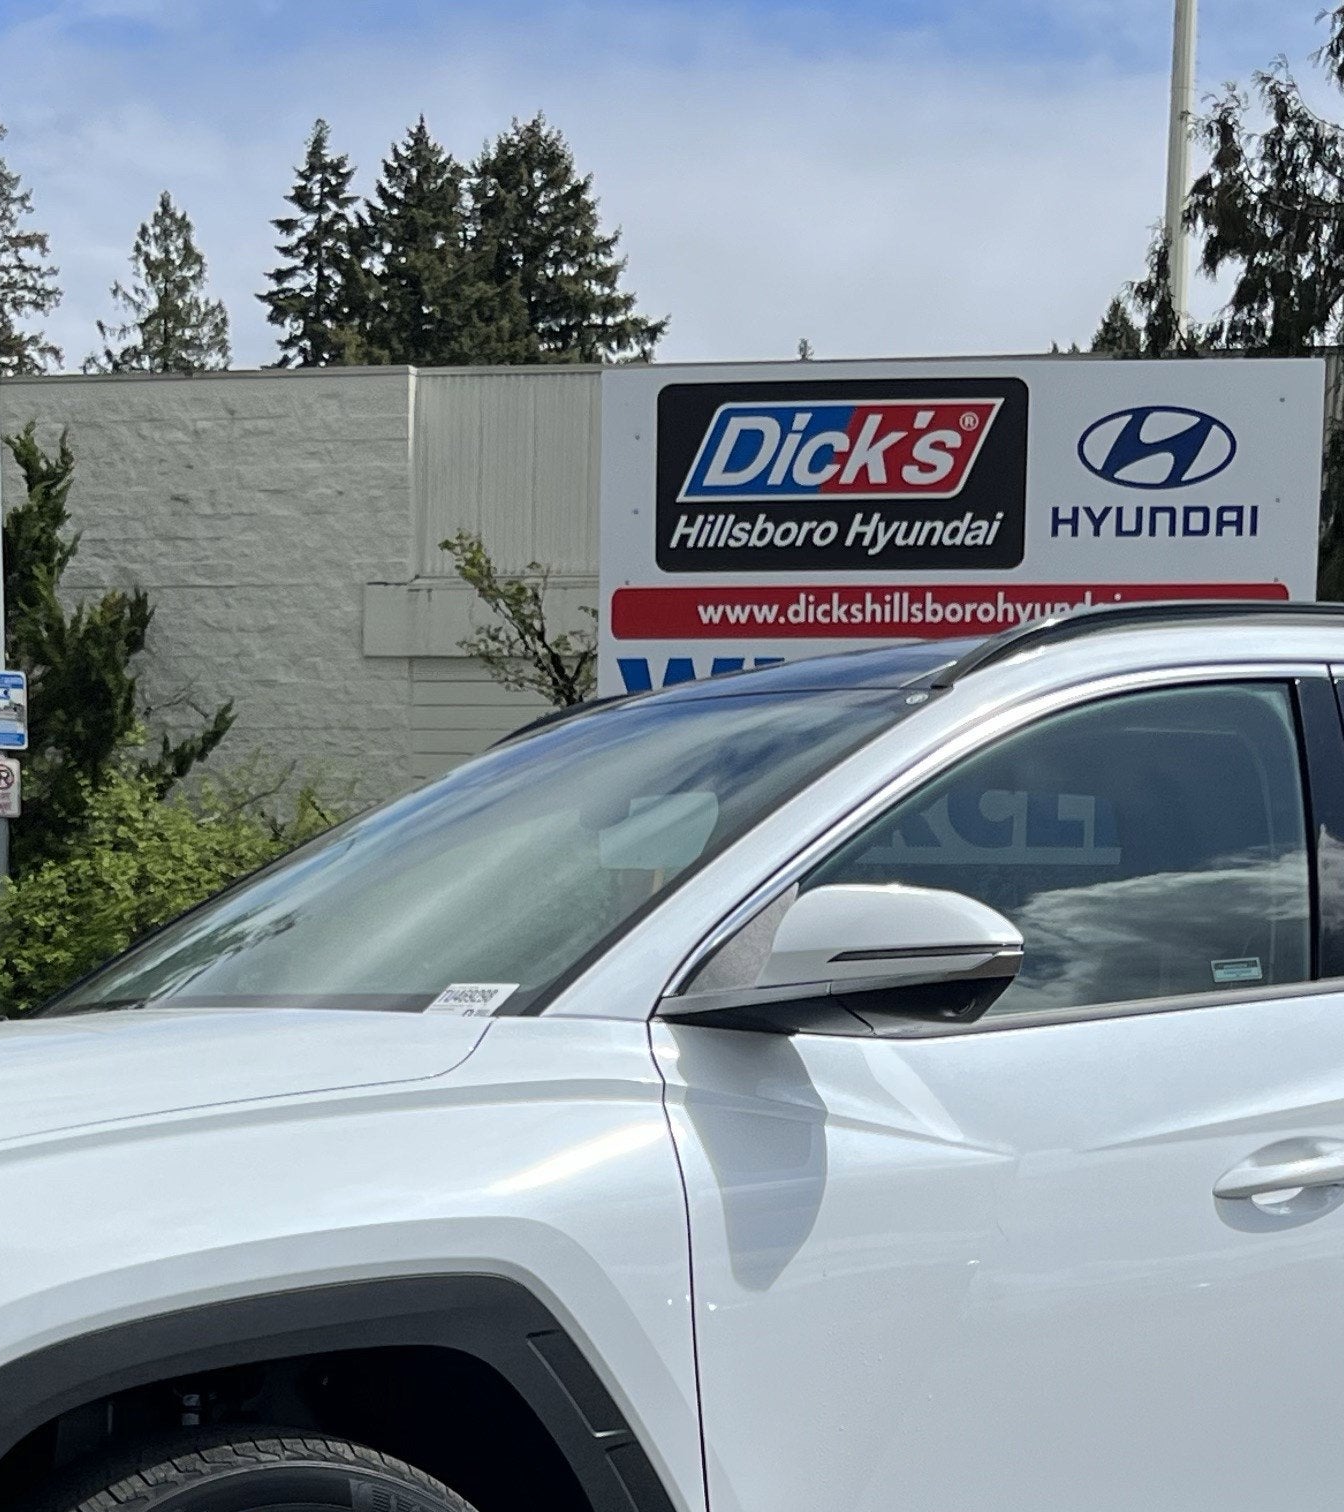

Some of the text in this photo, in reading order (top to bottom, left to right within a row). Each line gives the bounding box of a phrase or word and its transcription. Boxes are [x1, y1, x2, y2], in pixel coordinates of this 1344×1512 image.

[702, 409, 962, 487] Dick's
[669, 512, 1005, 556] Hillsboro Hyundai
[1051, 505, 1258, 539] HYUNDAI
